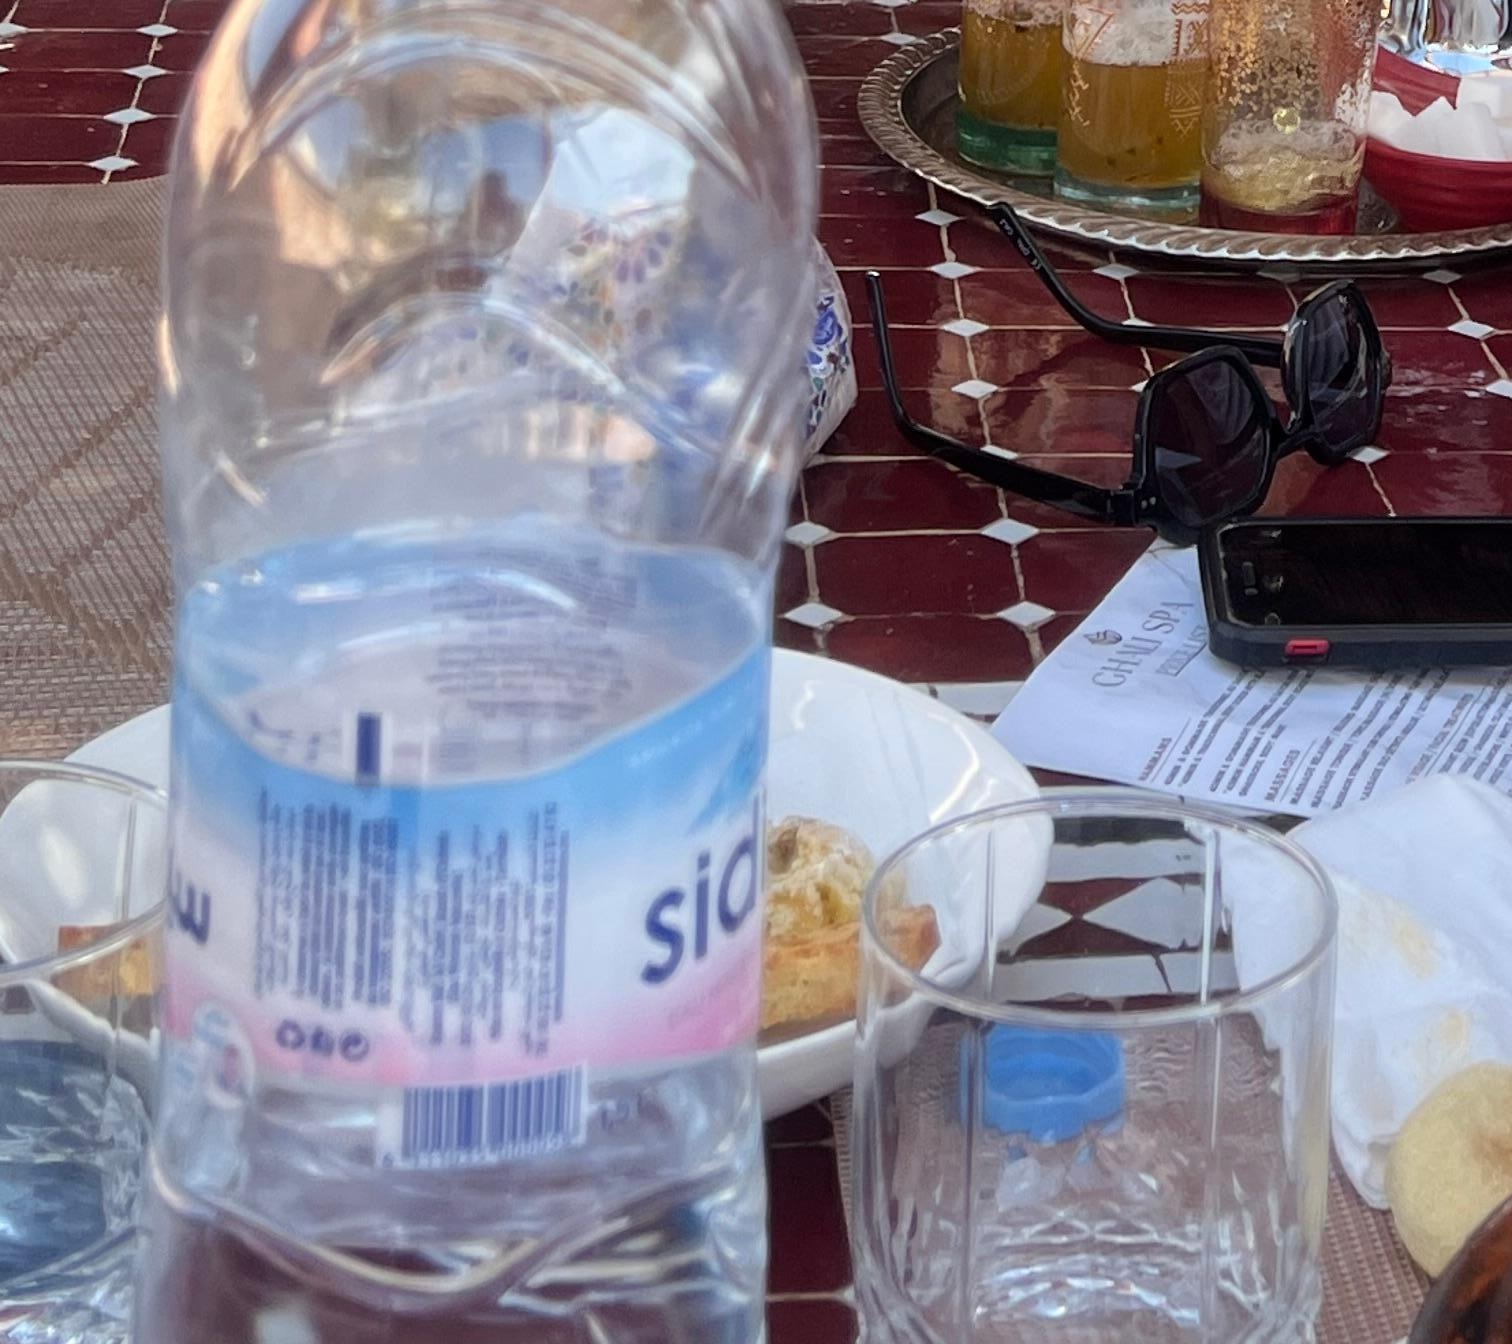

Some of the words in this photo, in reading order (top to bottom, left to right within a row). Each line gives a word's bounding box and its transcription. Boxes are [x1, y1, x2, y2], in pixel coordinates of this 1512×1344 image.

[1092, 637, 1163, 687] GHALI
[1142, 601, 1195, 633] SPA
[1264, 749, 1301, 801] MASSAGES
